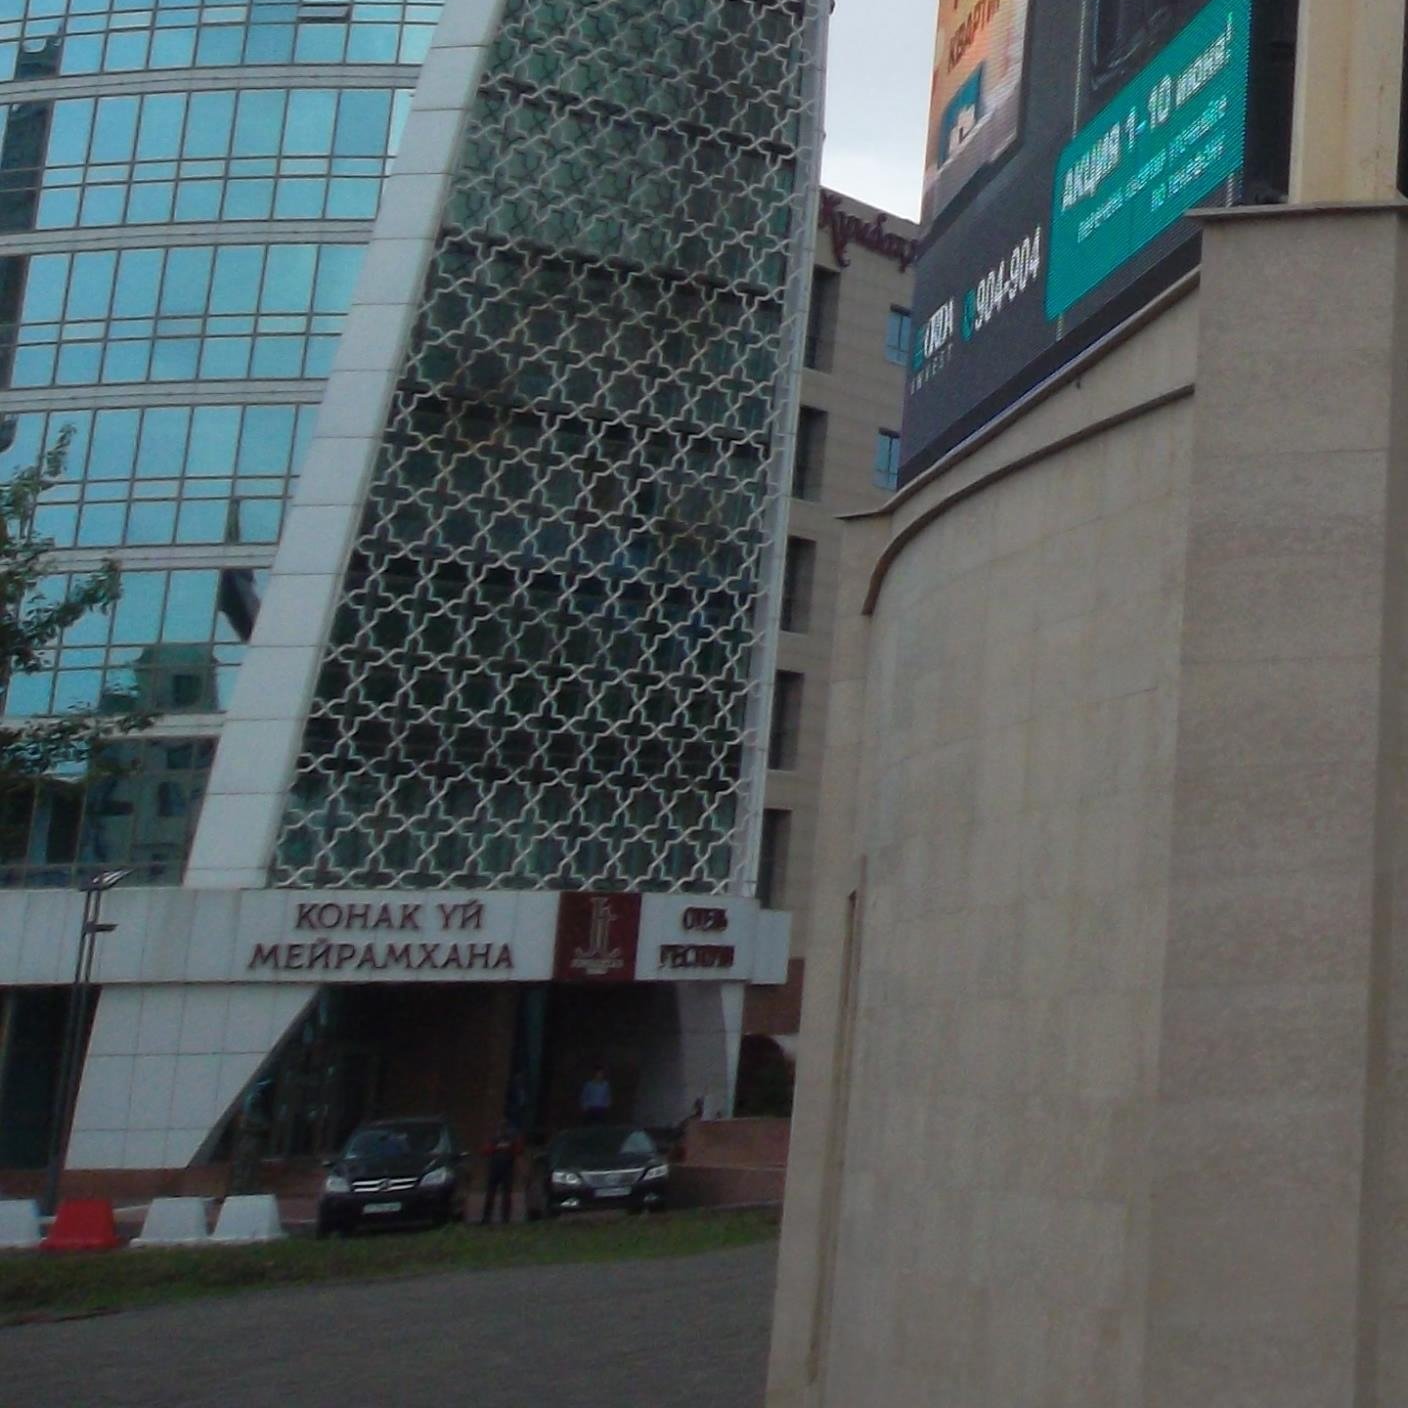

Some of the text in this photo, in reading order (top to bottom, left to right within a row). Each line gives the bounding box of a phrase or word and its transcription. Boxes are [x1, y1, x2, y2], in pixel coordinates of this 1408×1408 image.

[1061, 121, 1121, 212] АКЦИЯ
[975, 226, 1041, 331] 904-904
[248, 938, 515, 970] МЕЙРАМХАНА
